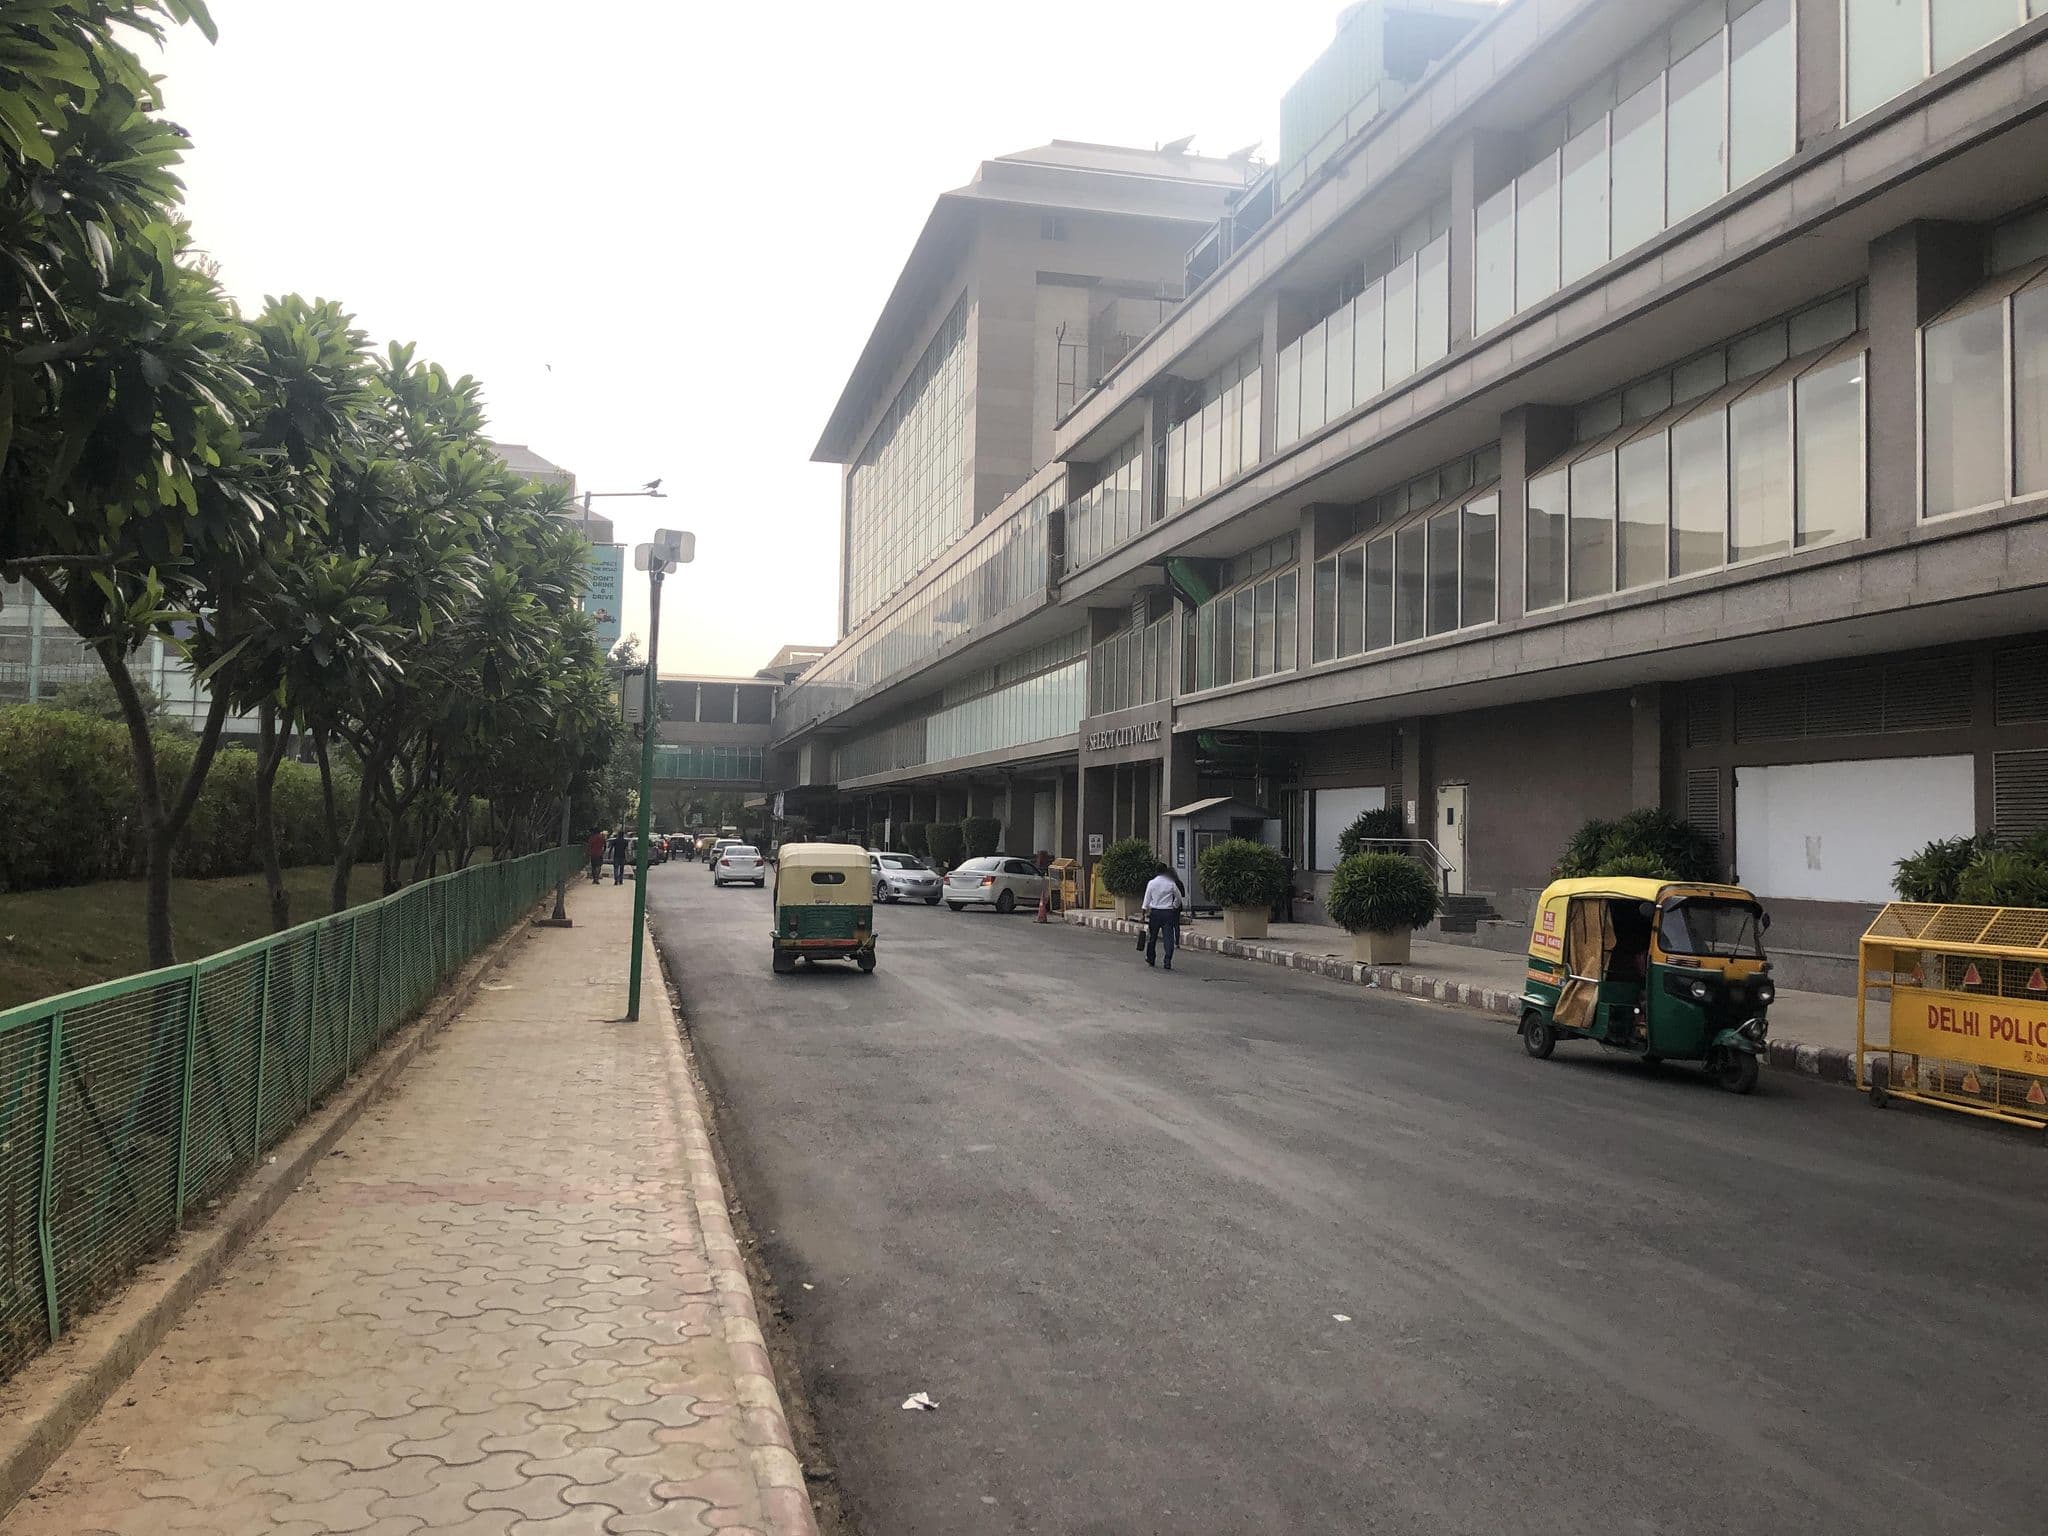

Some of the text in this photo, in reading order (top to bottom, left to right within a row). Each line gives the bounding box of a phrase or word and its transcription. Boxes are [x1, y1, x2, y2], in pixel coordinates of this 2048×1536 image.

[1089, 720, 1160, 751] SELECT CITYWALK
[1928, 1004, 1979, 1037] DELHI
